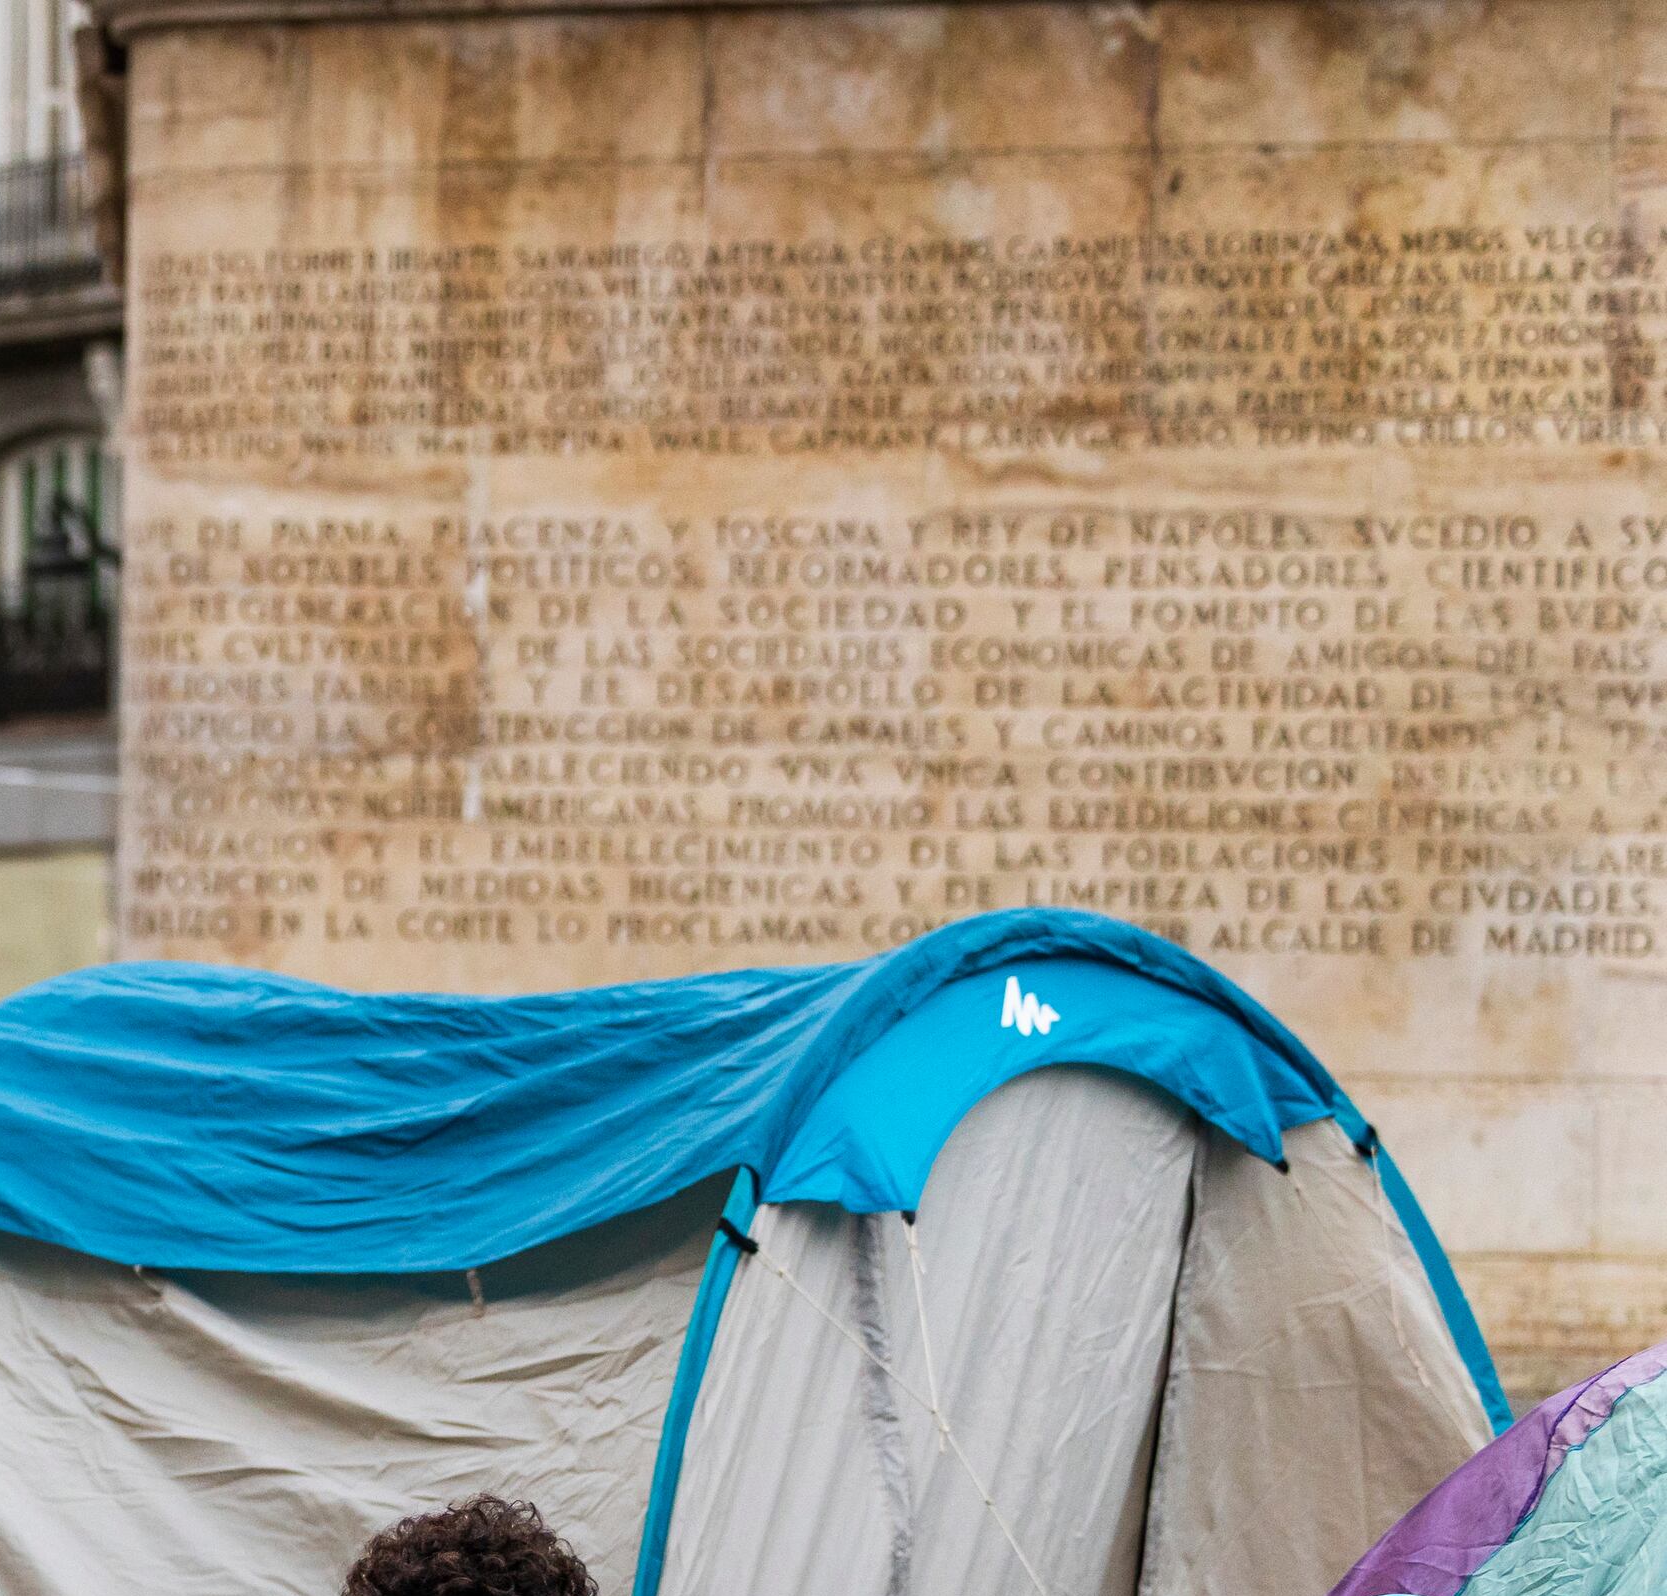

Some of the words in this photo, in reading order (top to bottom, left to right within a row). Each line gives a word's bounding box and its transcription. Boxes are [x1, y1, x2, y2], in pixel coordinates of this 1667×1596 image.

[431, 516, 639, 549] PIACENZA
[665, 516, 690, 549] Y
[714, 516, 882, 549] TOSCANA
[907, 515, 931, 549] Y
[950, 515, 1026, 549] REY
[1049, 515, 1100, 549] DE
[1352, 514, 1540, 549] SVCEDIO
[1566, 514, 1592, 549] A
[242, 555, 443, 587] NOTABLES
[538, 594, 590, 628] DE
[626, 594, 688, 629] LA
[717, 594, 968, 630] SOCIEDAD
[1012, 595, 1035, 631] Y
[1060, 596, 1102, 631] EL
[1130, 596, 1328, 632] FOMENTO
[1354, 597, 1403, 633] DE
[516, 634, 559, 667] DE
[585, 634, 653, 667] LAS
[675, 635, 908, 669] SOCIEDADES
[929, 636, 1187, 671] ECONOMICAS
[1210, 638, 1258, 671] DE
[1286, 638, 1453, 673] AMIGOS
[1475, 639, 1536, 673] DEL
[528, 674, 551, 706] Y
[580, 674, 626, 706] EL
[657, 674, 946, 708] DESARROLLO
[974, 676, 1028, 709] DE
[1060, 677, 1121, 709] LA
[1145, 678, 1385, 711] ACTIVIDAD
[1410, 679, 1455, 712] DE
[711, 714, 759, 747] DE
[785, 714, 969, 748] CANALES
[993, 715, 1015, 748] Y
[1040, 716, 1227, 749] CAMINOS
[894, 755, 1019, 790] VNICA
[1046, 756, 1359, 792] CONTRIBVCION
[727, 790, 939, 826] PROMOVIO
[955, 793, 1024, 827] LAS
[1047, 793, 1318, 830] EXPEDICIONES
[490, 829, 882, 868] EMBELLECIMIENTO
[909, 833, 965, 869] DE
[994, 834, 1074, 870] LAS
[1101, 835, 1390, 873] POBLACIONES
[342, 868, 390, 901] DE
[421, 869, 604, 903] MEDIDAS
[627, 871, 865, 906] HIGIENICAS
[895, 873, 916, 907] Y
[945, 873, 992, 908] DE
[1024, 874, 1219, 910] LIMPIEZA
[1245, 876, 1300, 911] DE
[1325, 877, 1405, 912] LAS
[257, 908, 304, 944] EN
[324, 909, 373, 945] LA
[395, 910, 518, 946] CORTE
[536, 911, 591, 947] LO
[606, 912, 842, 950] PROCLAMAN
[1211, 918, 1386, 956] ALCALDE
[1411, 920, 1457, 957] DE
